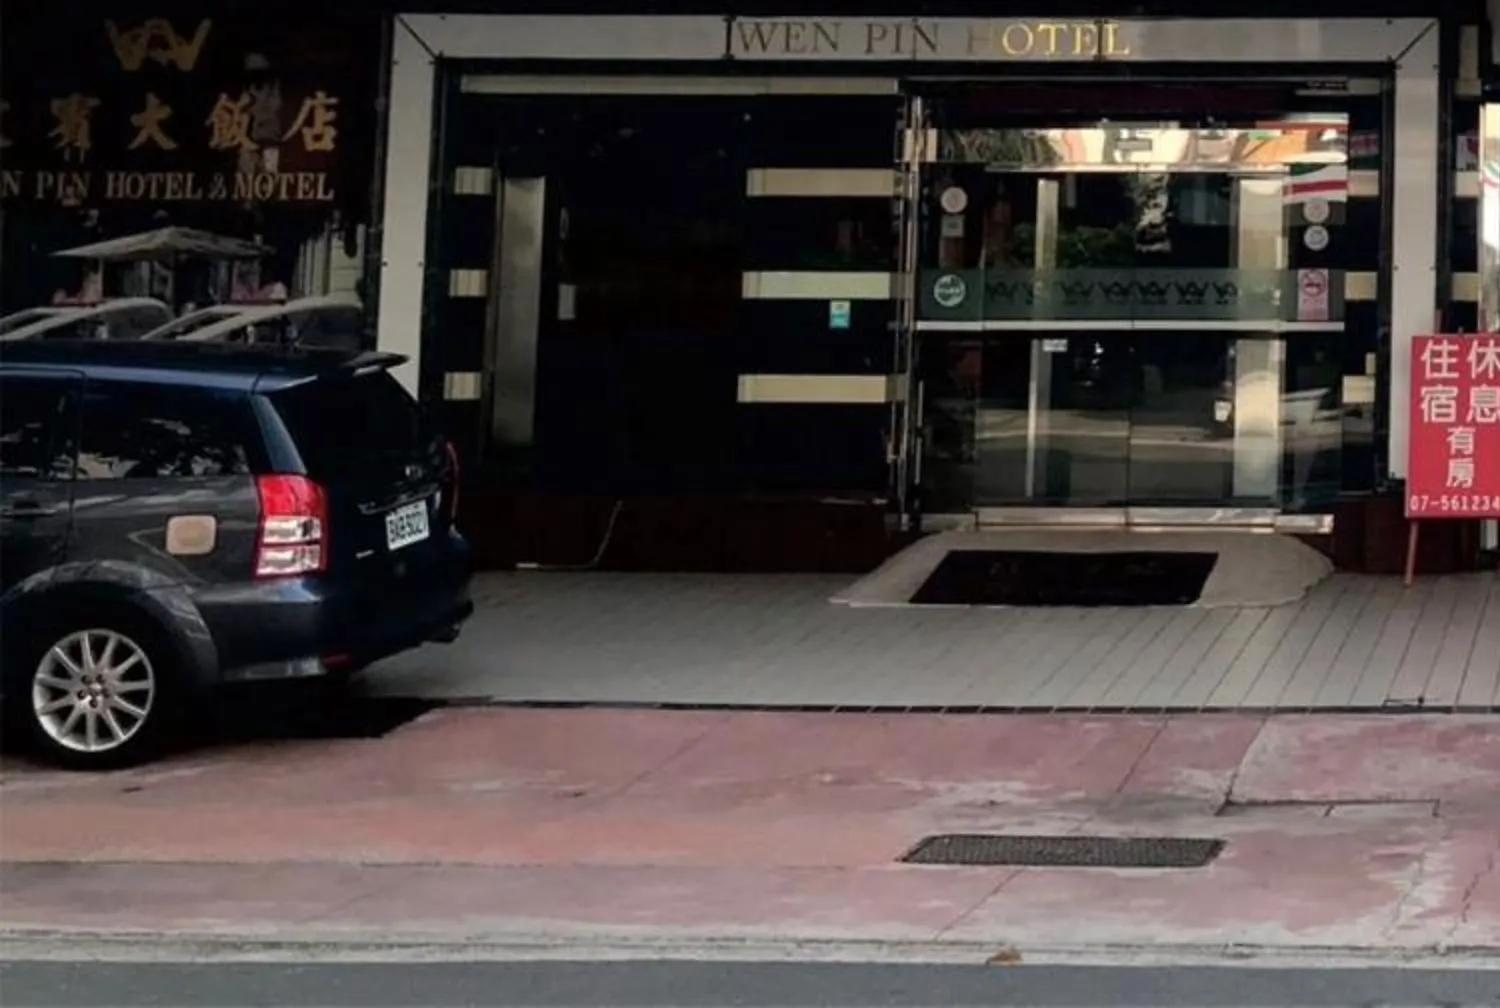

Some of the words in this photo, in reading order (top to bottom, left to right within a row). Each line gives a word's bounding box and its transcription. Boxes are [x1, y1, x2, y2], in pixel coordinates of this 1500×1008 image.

[735, 22, 842, 54] WEN
[864, 21, 939, 54] PIN
[967, 22, 1131, 56] HOTEL
[36, 171, 91, 200] PIN
[106, 172, 200, 201] HOTEL
[1446, 425, 1476, 489] 有房
